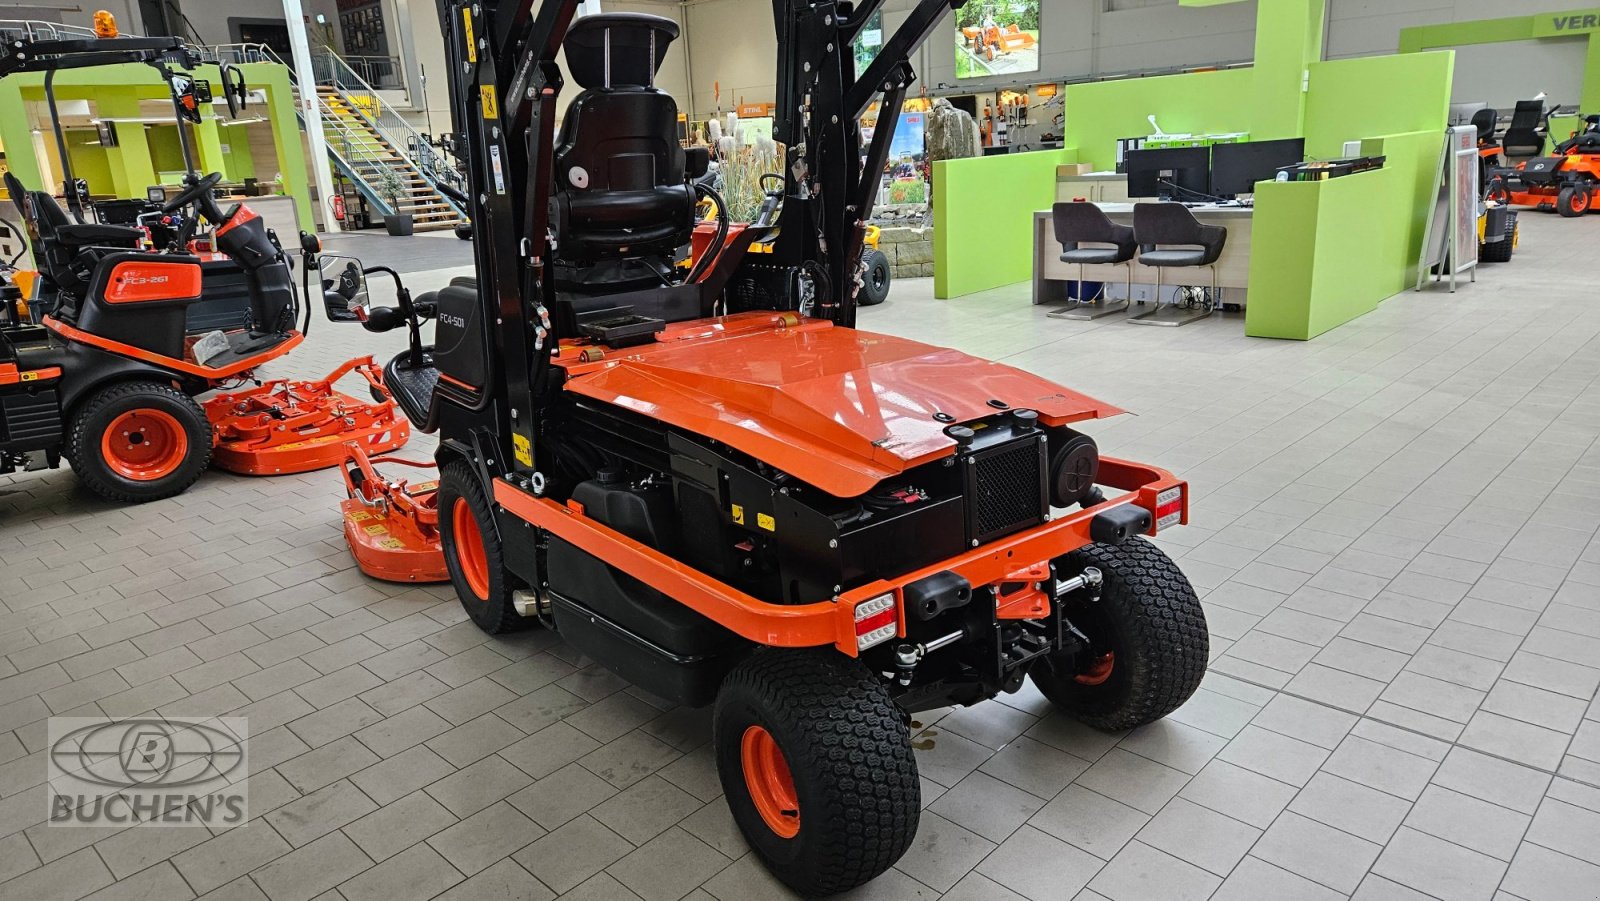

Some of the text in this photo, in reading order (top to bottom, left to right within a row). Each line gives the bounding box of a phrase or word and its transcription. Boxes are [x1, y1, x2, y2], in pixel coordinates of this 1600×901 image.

[1553, 14, 1600, 31] VER
[125, 276, 168, 284] FC3-261
[440, 313, 464, 328] FC4-501
